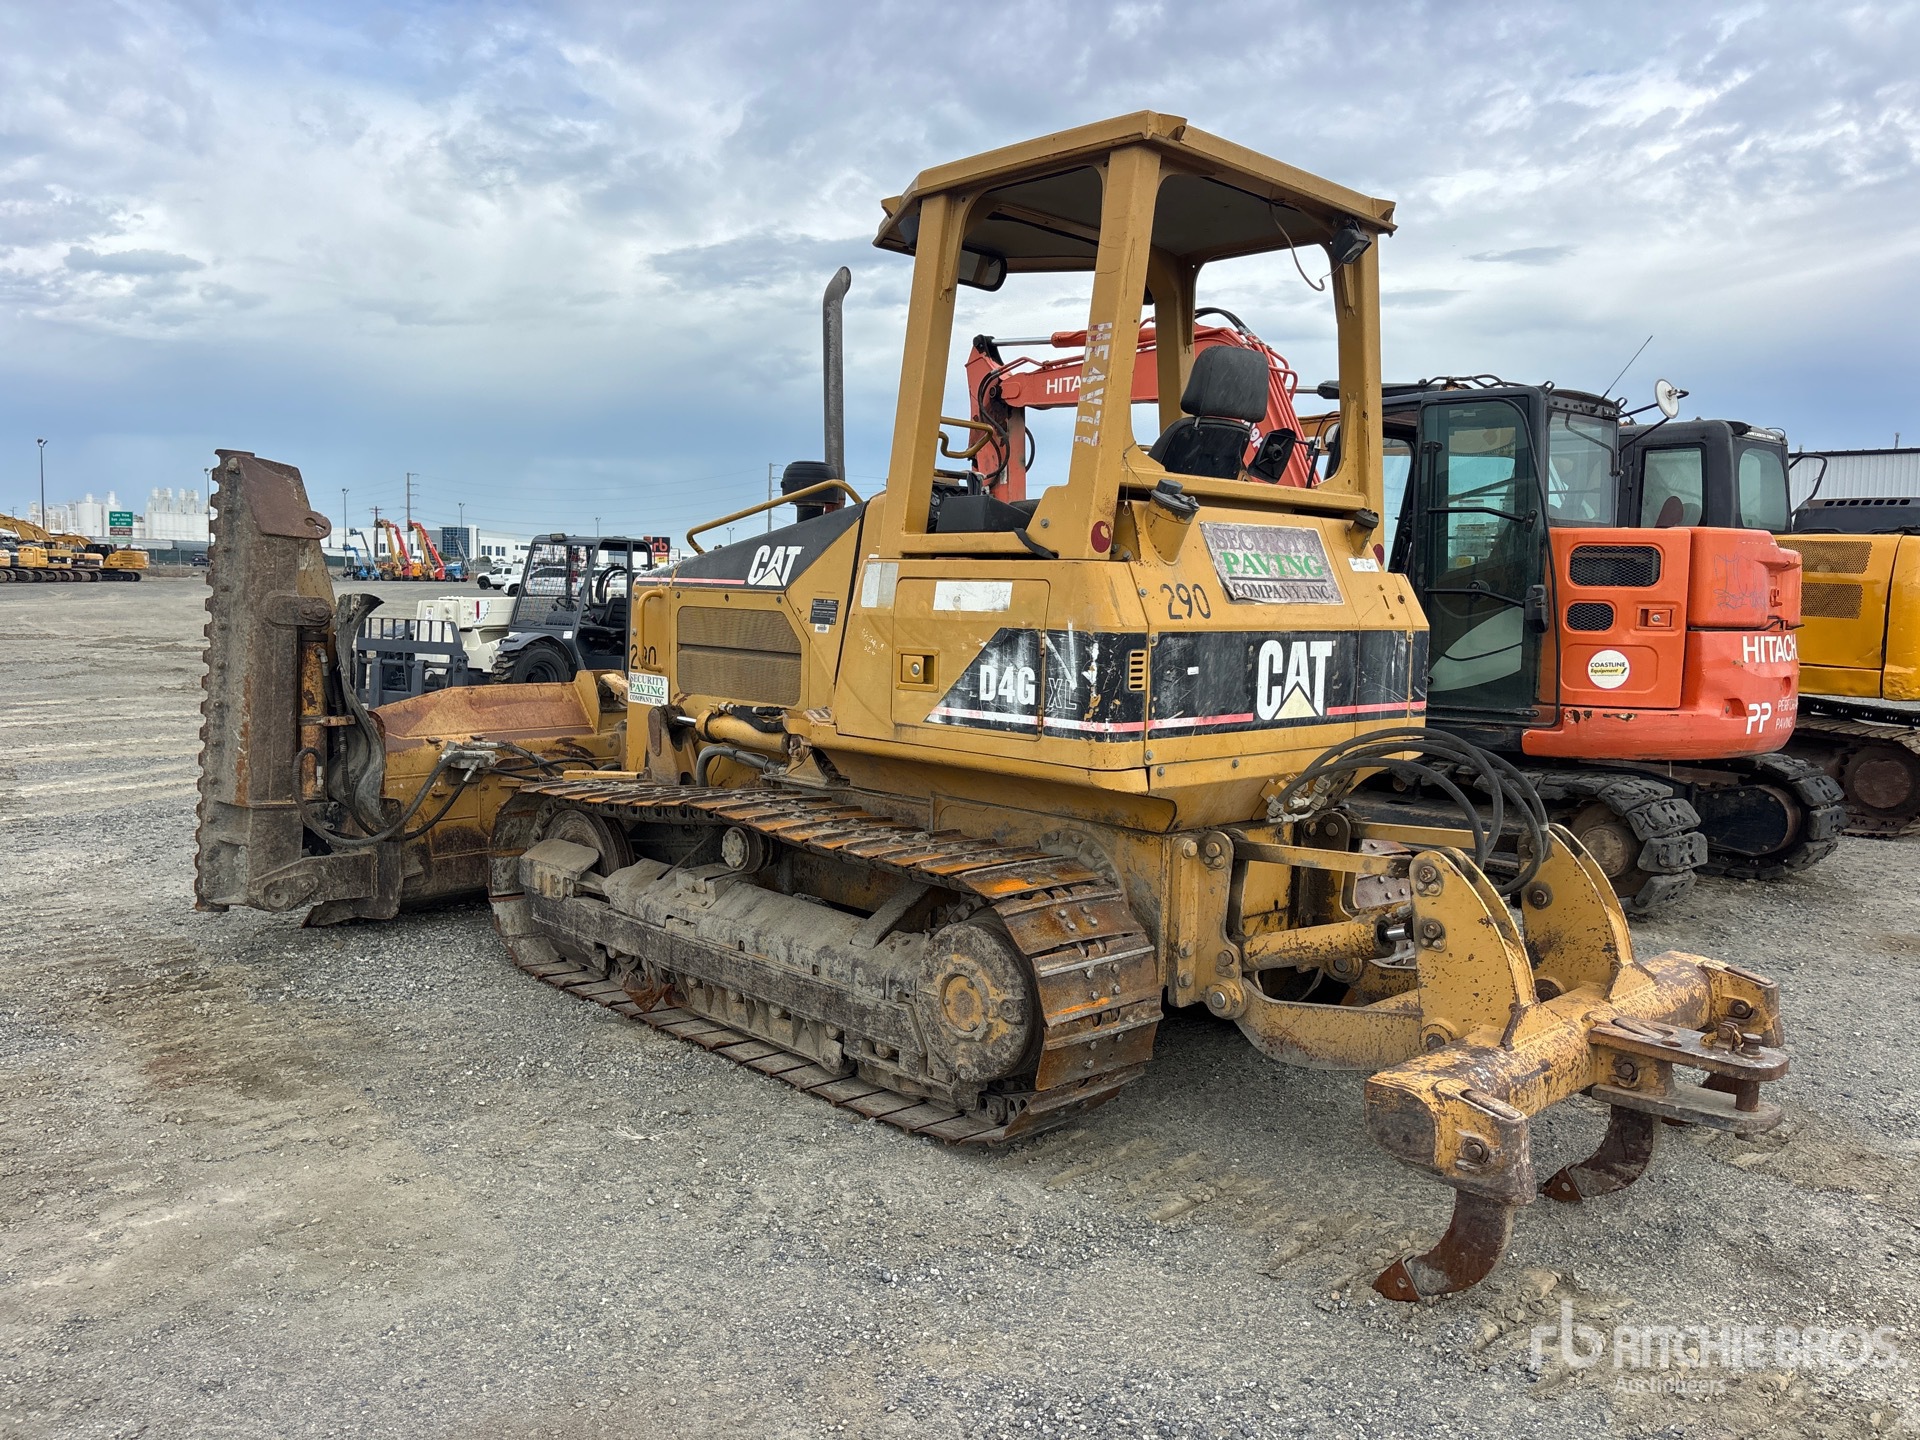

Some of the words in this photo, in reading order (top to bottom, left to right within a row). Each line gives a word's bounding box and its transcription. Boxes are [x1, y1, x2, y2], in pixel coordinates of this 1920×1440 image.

[1046, 375, 1081, 395] HITA
[747, 544, 803, 587] CAT
[1221, 551, 1323, 577] PAVING
[1160, 583, 1211, 620] 290
[1307, 585, 1334, 600] INC.
[1742, 634, 1798, 663] HITACH
[630, 674, 665, 687] SECURITY
[630, 683, 665, 696] PAVING
[979, 664, 1036, 706] D4G
[1047, 677, 1077, 711] XL
[1256, 639, 1333, 721] CAT
[1746, 702, 1772, 735] PP
